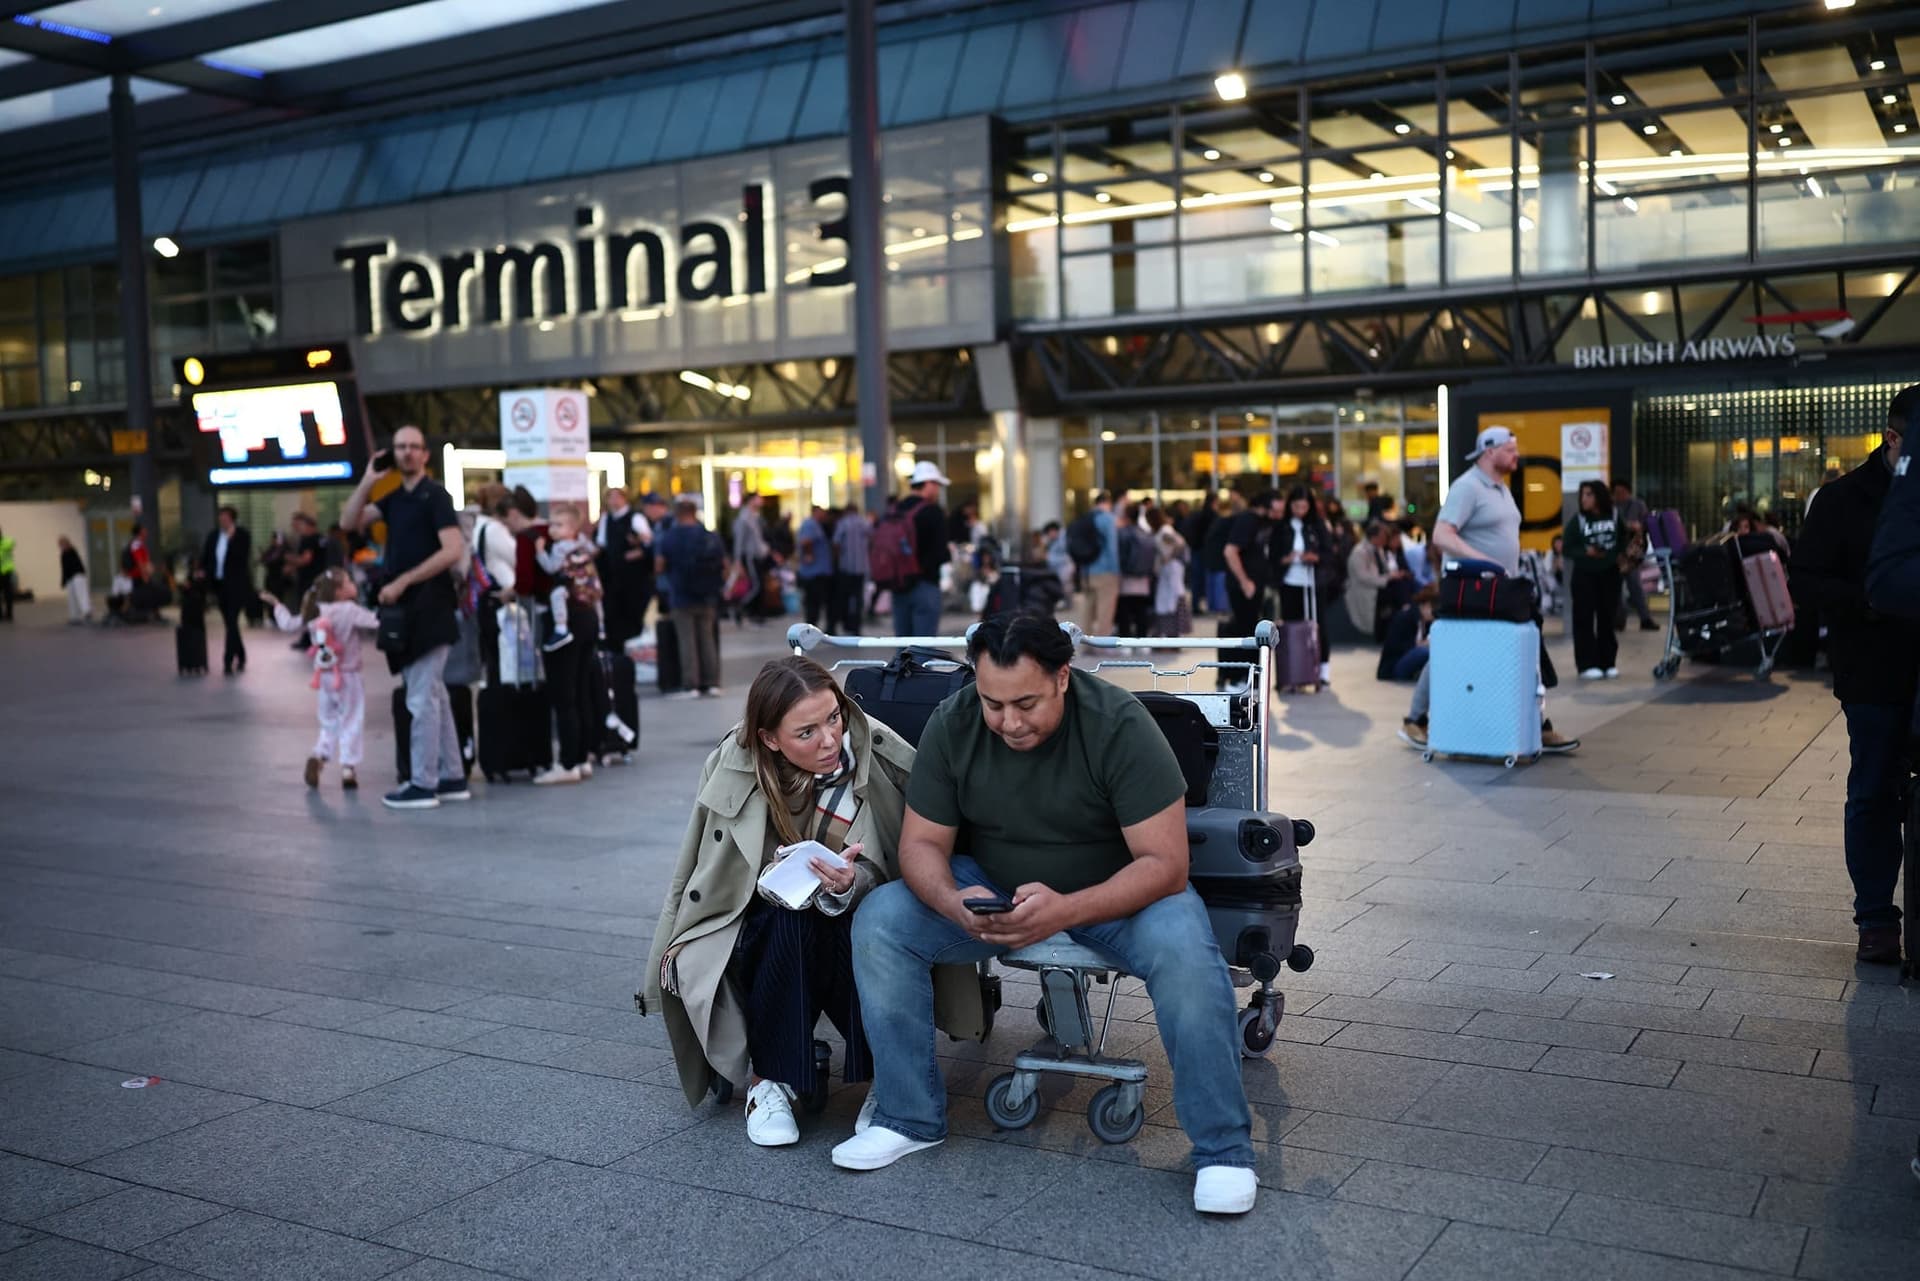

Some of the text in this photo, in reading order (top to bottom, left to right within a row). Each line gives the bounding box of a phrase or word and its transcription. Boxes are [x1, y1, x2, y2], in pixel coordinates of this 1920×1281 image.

[335, 177, 853, 334] Terminal 3
[1573, 334, 1796, 368] BRITISH AIRWAYS
